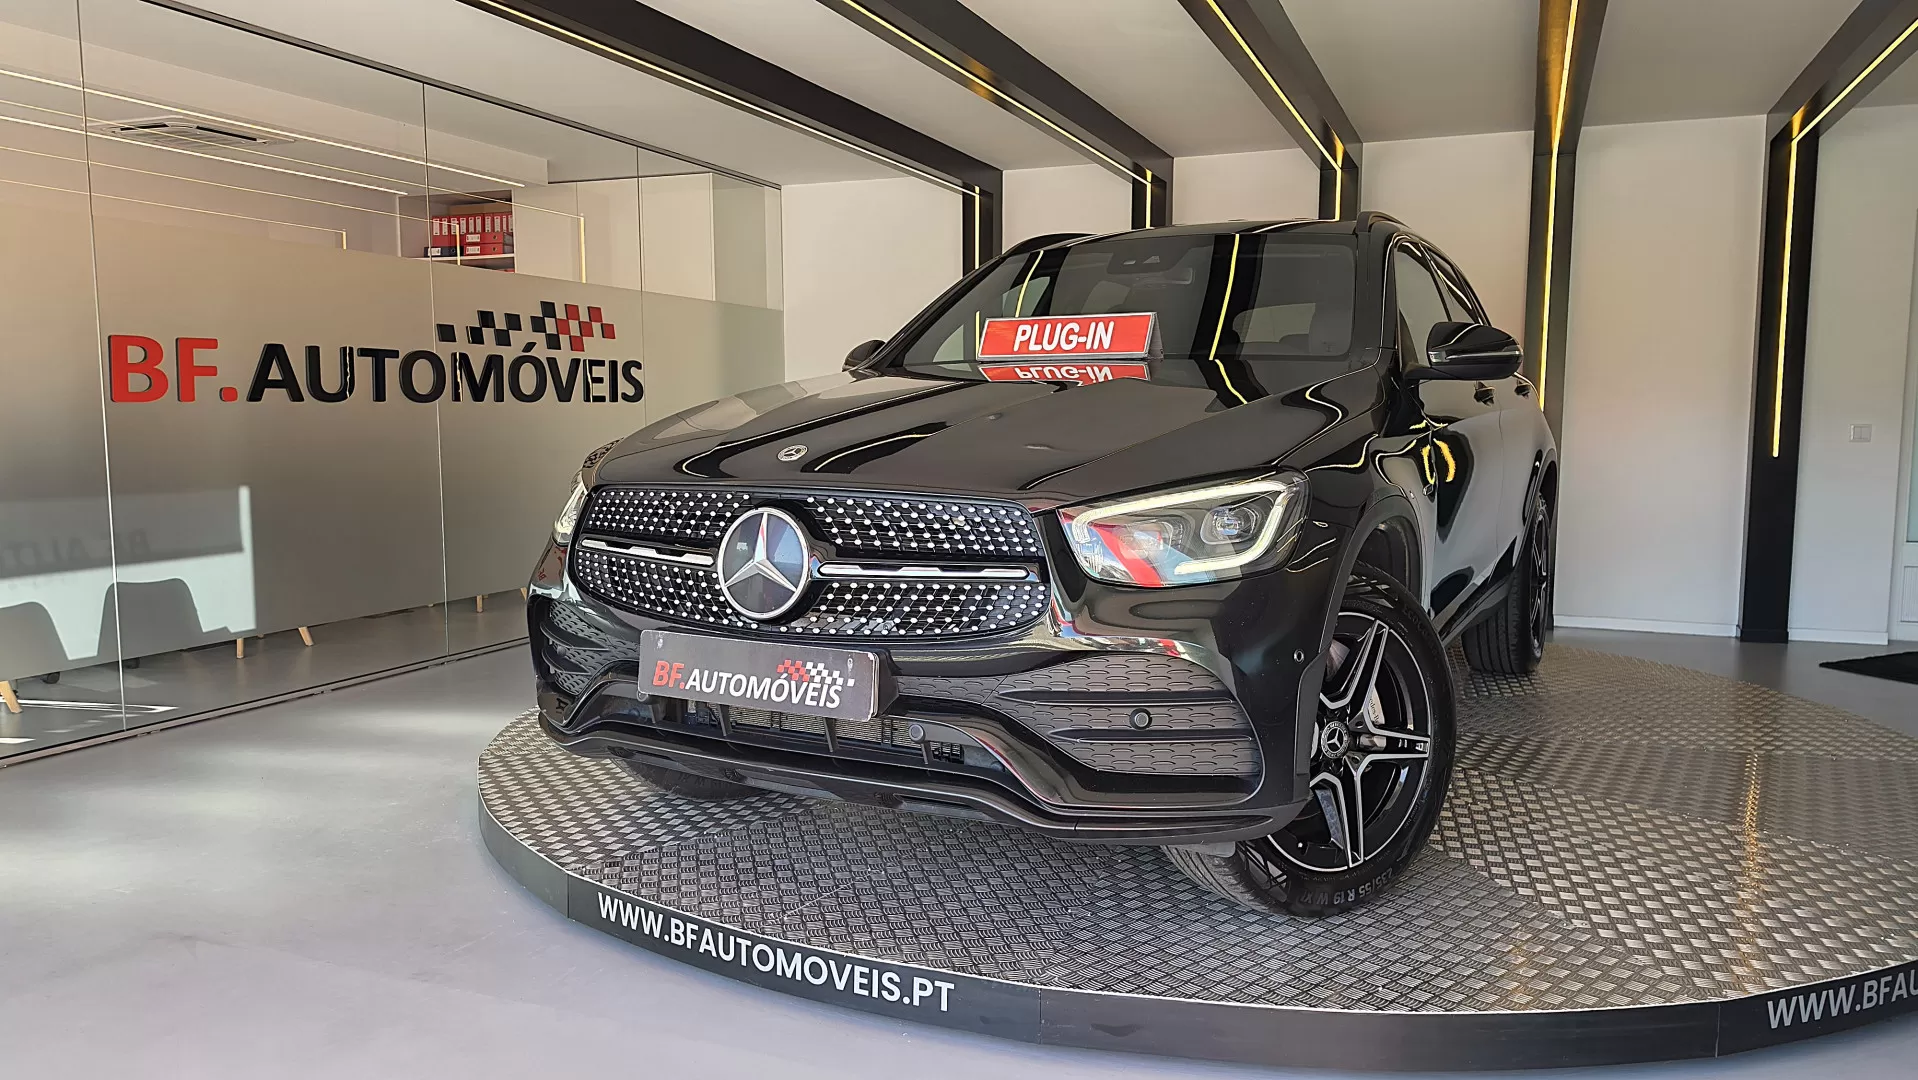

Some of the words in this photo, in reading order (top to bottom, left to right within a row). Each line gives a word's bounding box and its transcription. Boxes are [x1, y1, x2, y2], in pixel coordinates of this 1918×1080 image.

[1013, 320, 1115, 352] PLUG-IN
[652, 659, 844, 709] BF.AUTOMÓVEIS
[597, 891, 955, 1012] WWW.BFAUTOMOVEIS.PT
